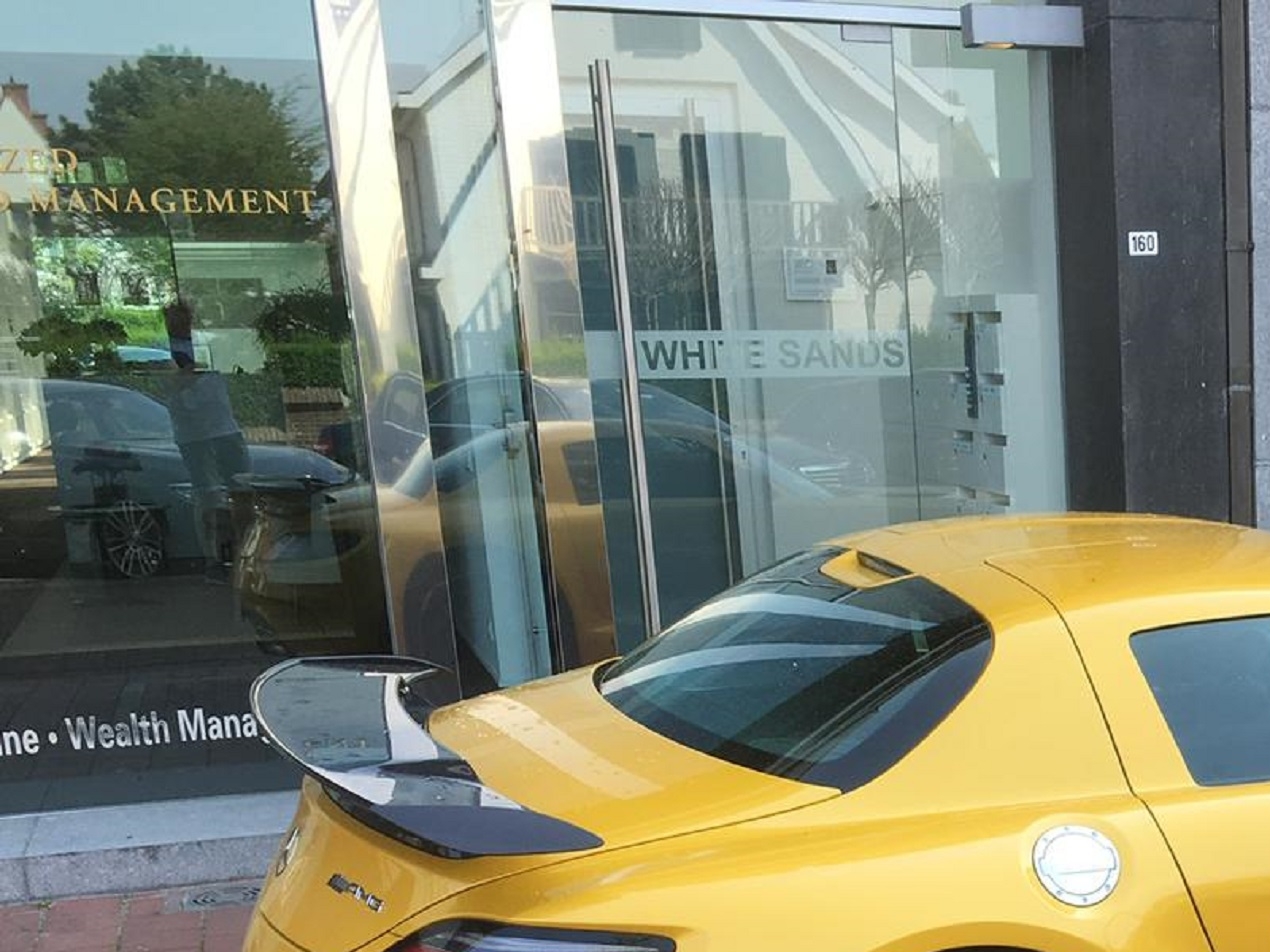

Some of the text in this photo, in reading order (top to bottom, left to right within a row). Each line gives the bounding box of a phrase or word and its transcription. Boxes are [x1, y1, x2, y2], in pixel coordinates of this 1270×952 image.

[31, 185, 317, 214] MANAGEMENT
[1132, 234, 1155, 252] 160
[778, 339, 905, 369] SANDS
[64, 710, 171, 750] Wealth
[177, 707, 271, 744] Mana
